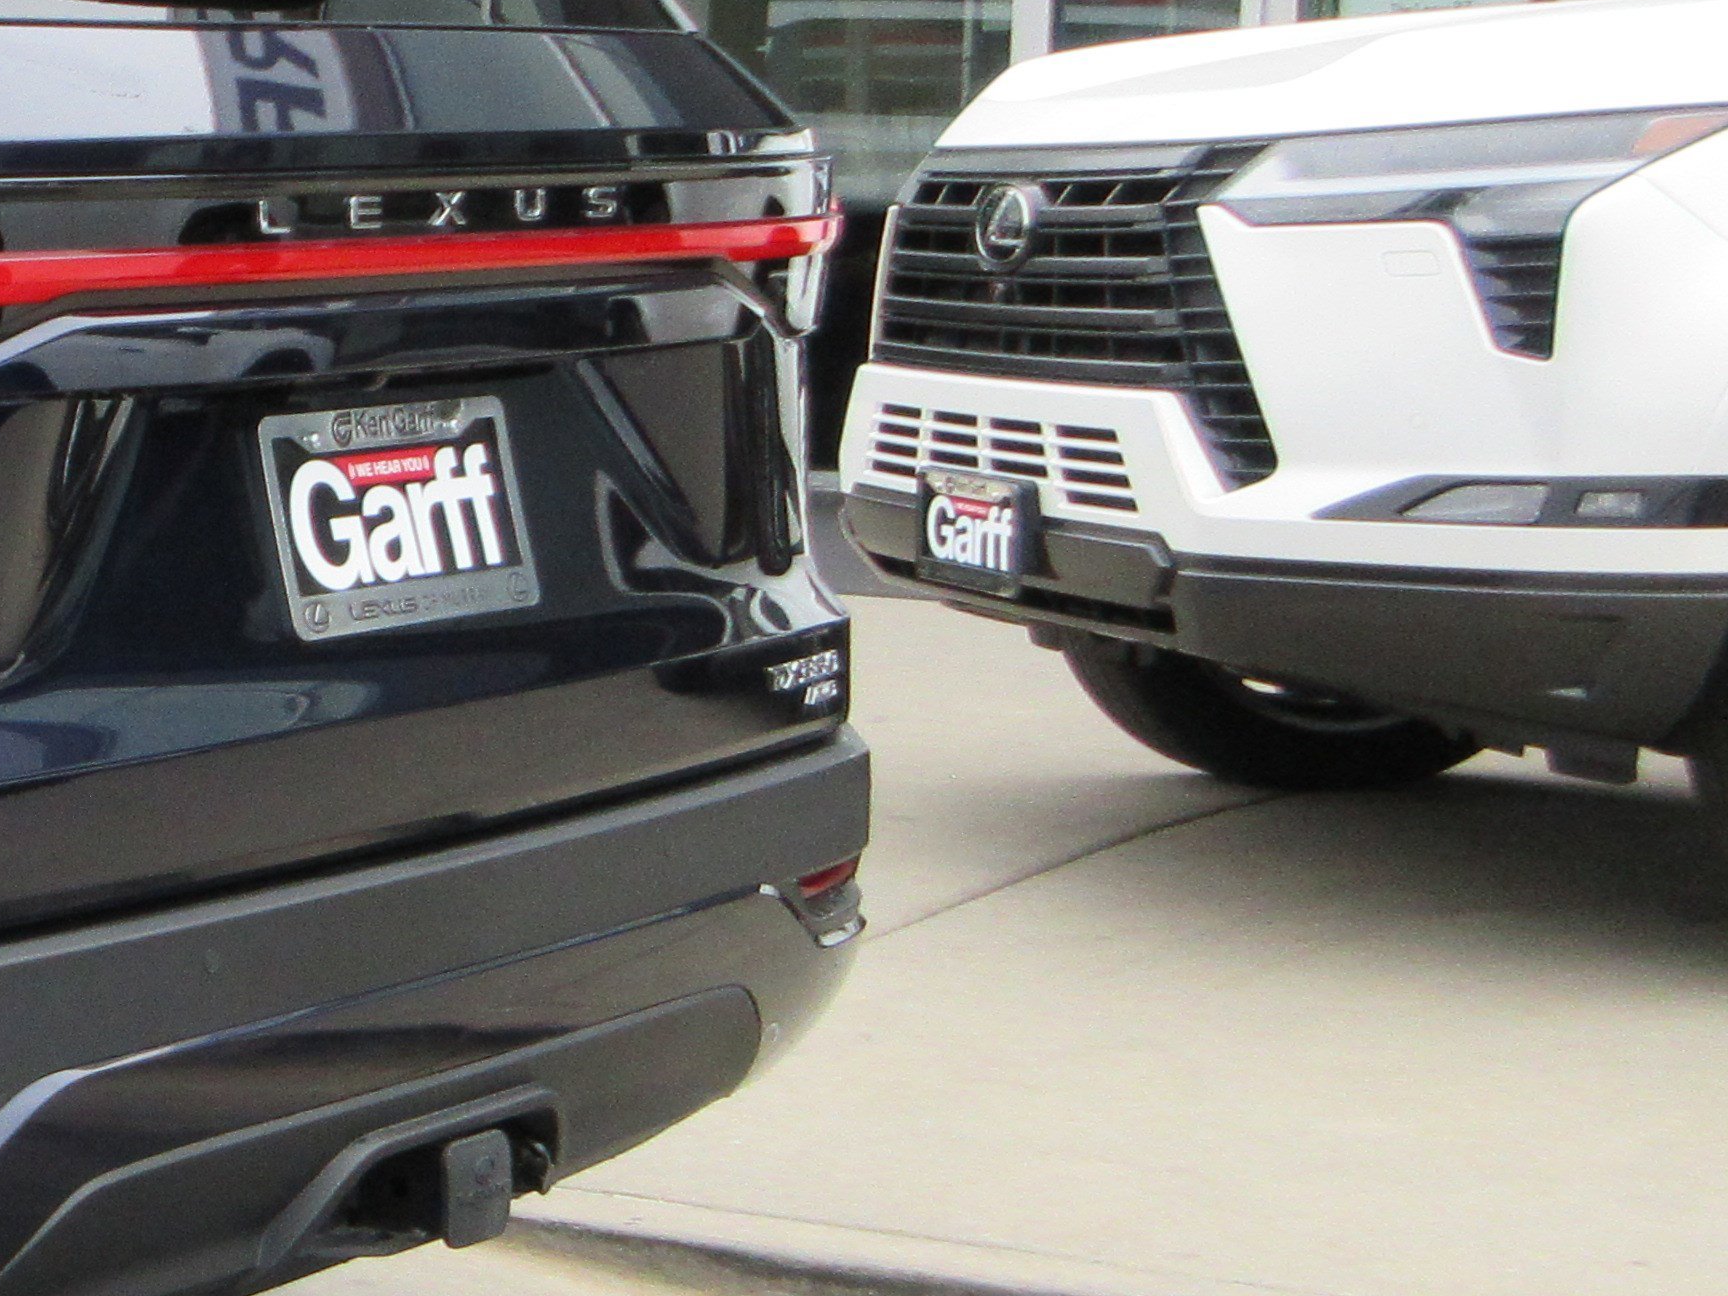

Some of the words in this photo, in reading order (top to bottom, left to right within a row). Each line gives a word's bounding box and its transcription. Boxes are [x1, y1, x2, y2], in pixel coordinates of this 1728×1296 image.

[258, 186, 621, 235] LEXUS
[355, 462, 374, 477] WE
[401, 457, 423, 472] YOU
[290, 443, 503, 591] Garff
[927, 494, 1013, 572] Garff
[348, 596, 418, 621] LEXUS
